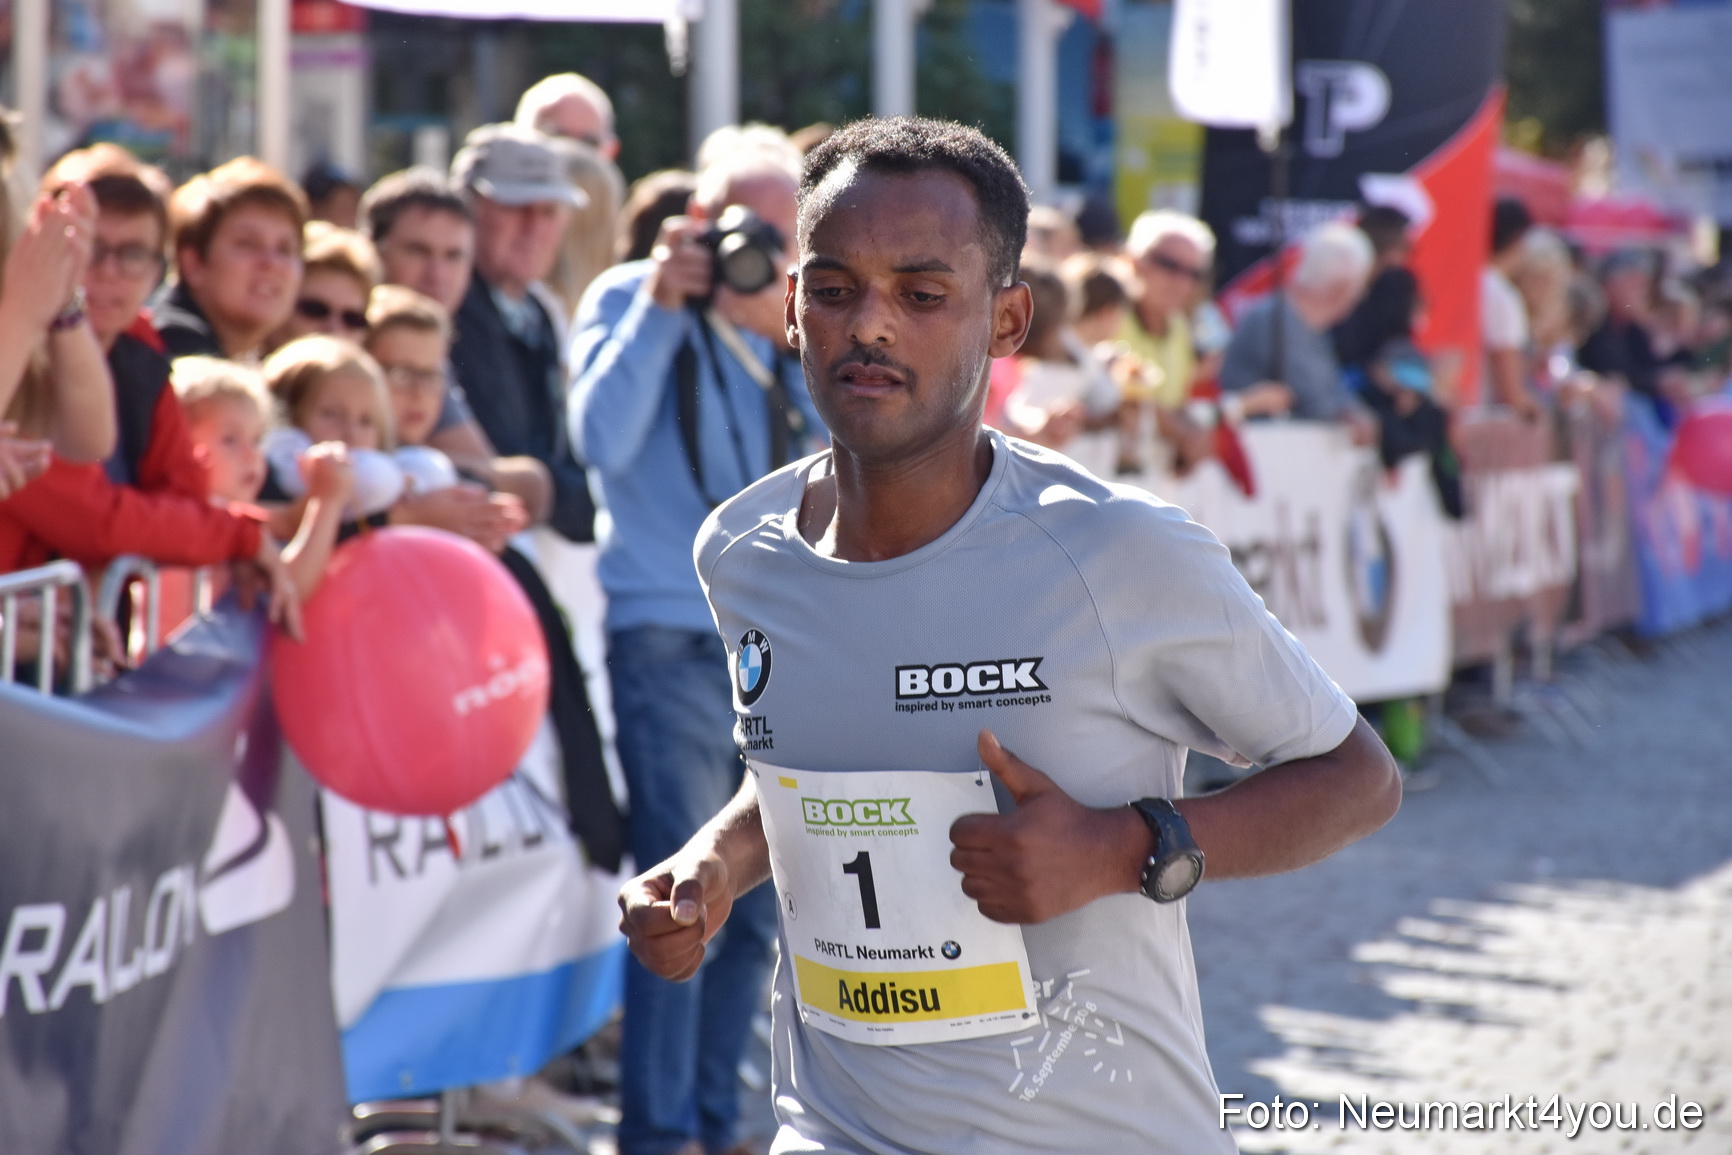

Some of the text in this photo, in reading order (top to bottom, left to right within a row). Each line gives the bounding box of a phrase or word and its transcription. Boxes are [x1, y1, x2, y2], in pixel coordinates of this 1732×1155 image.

[896, 657, 1044, 700] BOCK
[895, 693, 1052, 713] inspired by smart concepts
[738, 715, 773, 736] ARTL
[801, 797, 916, 827] BOCK
[805, 825, 920, 838] inspired by smart concepts
[842, 850, 882, 930] 1
[814, 936, 854, 959] PARTL
[856, 943, 935, 961] Neumarkt
[838, 979, 941, 1015] Addisu
[1032, 1023, 1079, 1088] Septembe
[1074, 1000, 1098, 1027] 208
